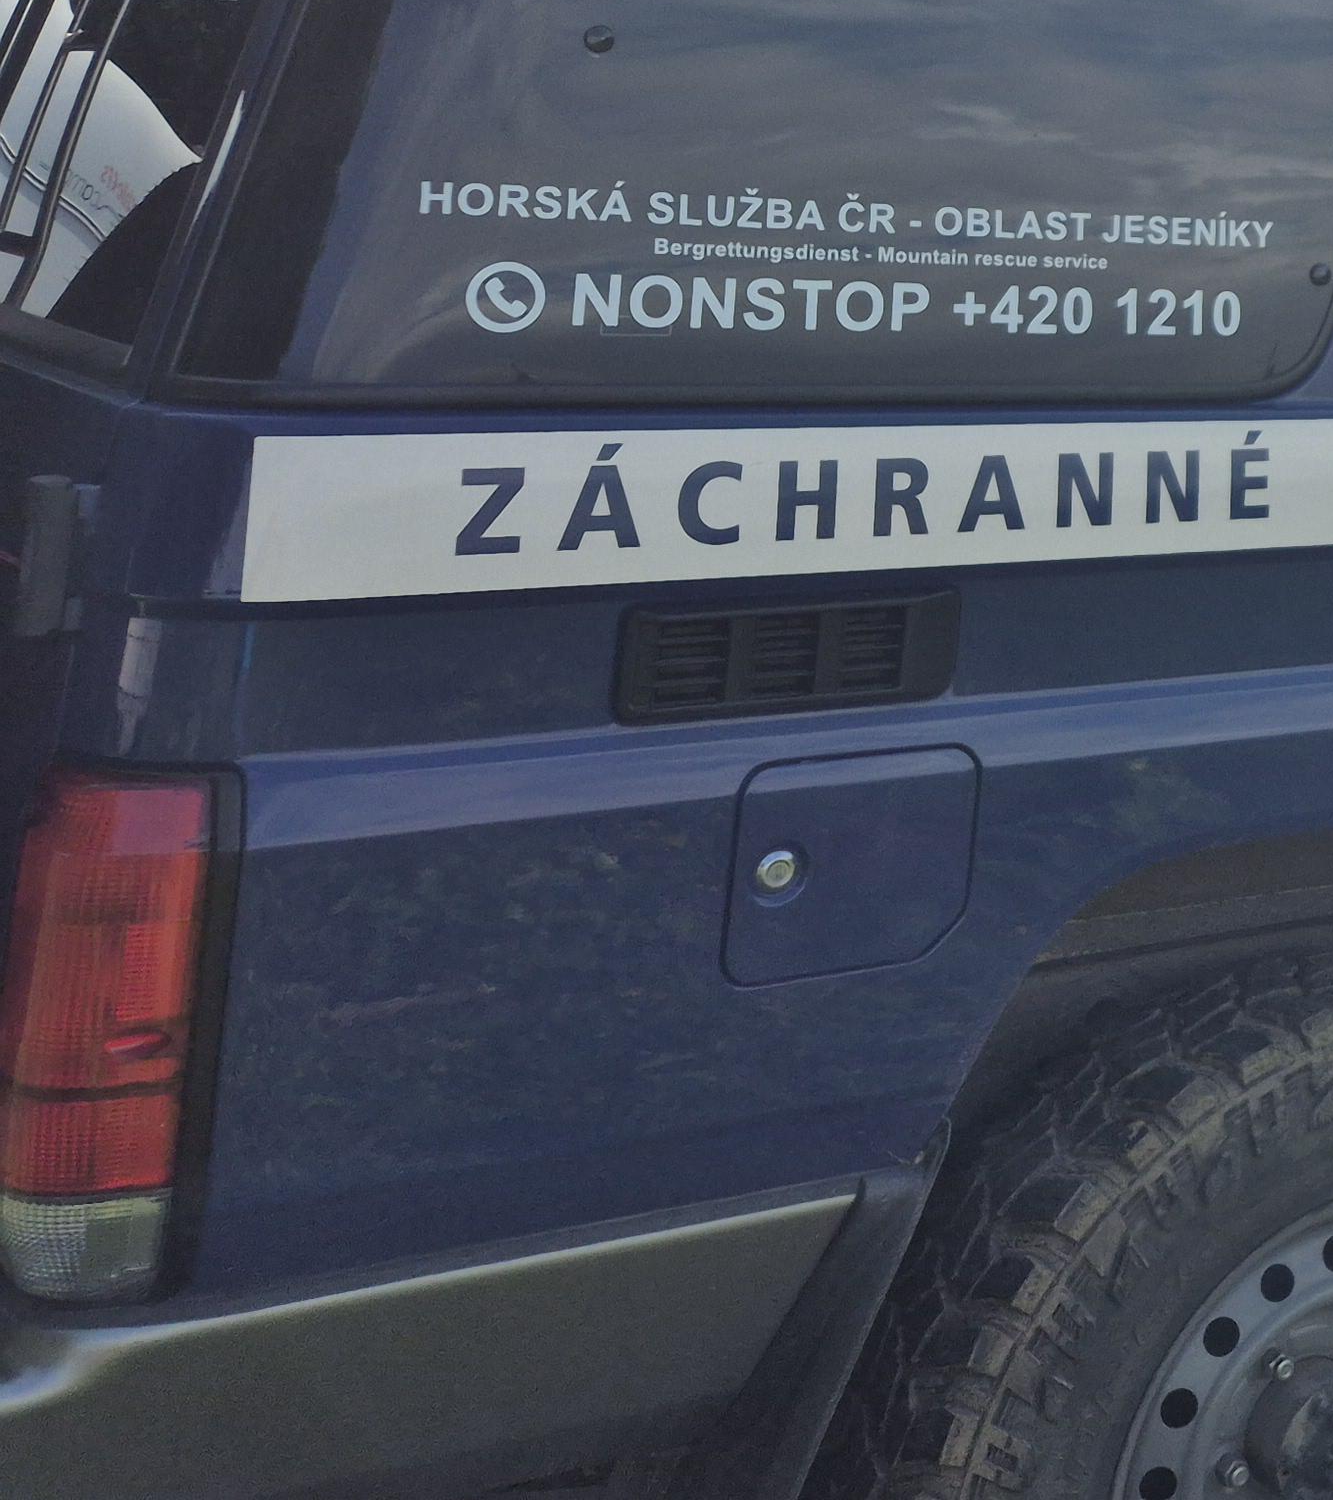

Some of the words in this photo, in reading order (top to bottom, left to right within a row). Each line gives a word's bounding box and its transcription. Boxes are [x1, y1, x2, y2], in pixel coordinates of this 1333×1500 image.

[418, 180, 632, 223] HORSKÁ
[647, 187, 826, 231] SLUŽBA
[838, 192, 896, 234] ČR
[909, 220, 923, 229] -
[934, 206, 1092, 242] OBLAST
[1102, 211, 1274, 248] JESENÍKY
[653, 237, 860, 263] Bergrettungsdienst
[878, 246, 968, 267] Mountain
[975, 250, 1038, 268] rescue
[1043, 251, 1109, 270] service
[571, 272, 930, 332] NONSTOP
[953, 284, 1094, 335] +420
[1116, 287, 1242, 336] 1210
[455, 430, 1272, 556] ZÁCHRANNÉ
